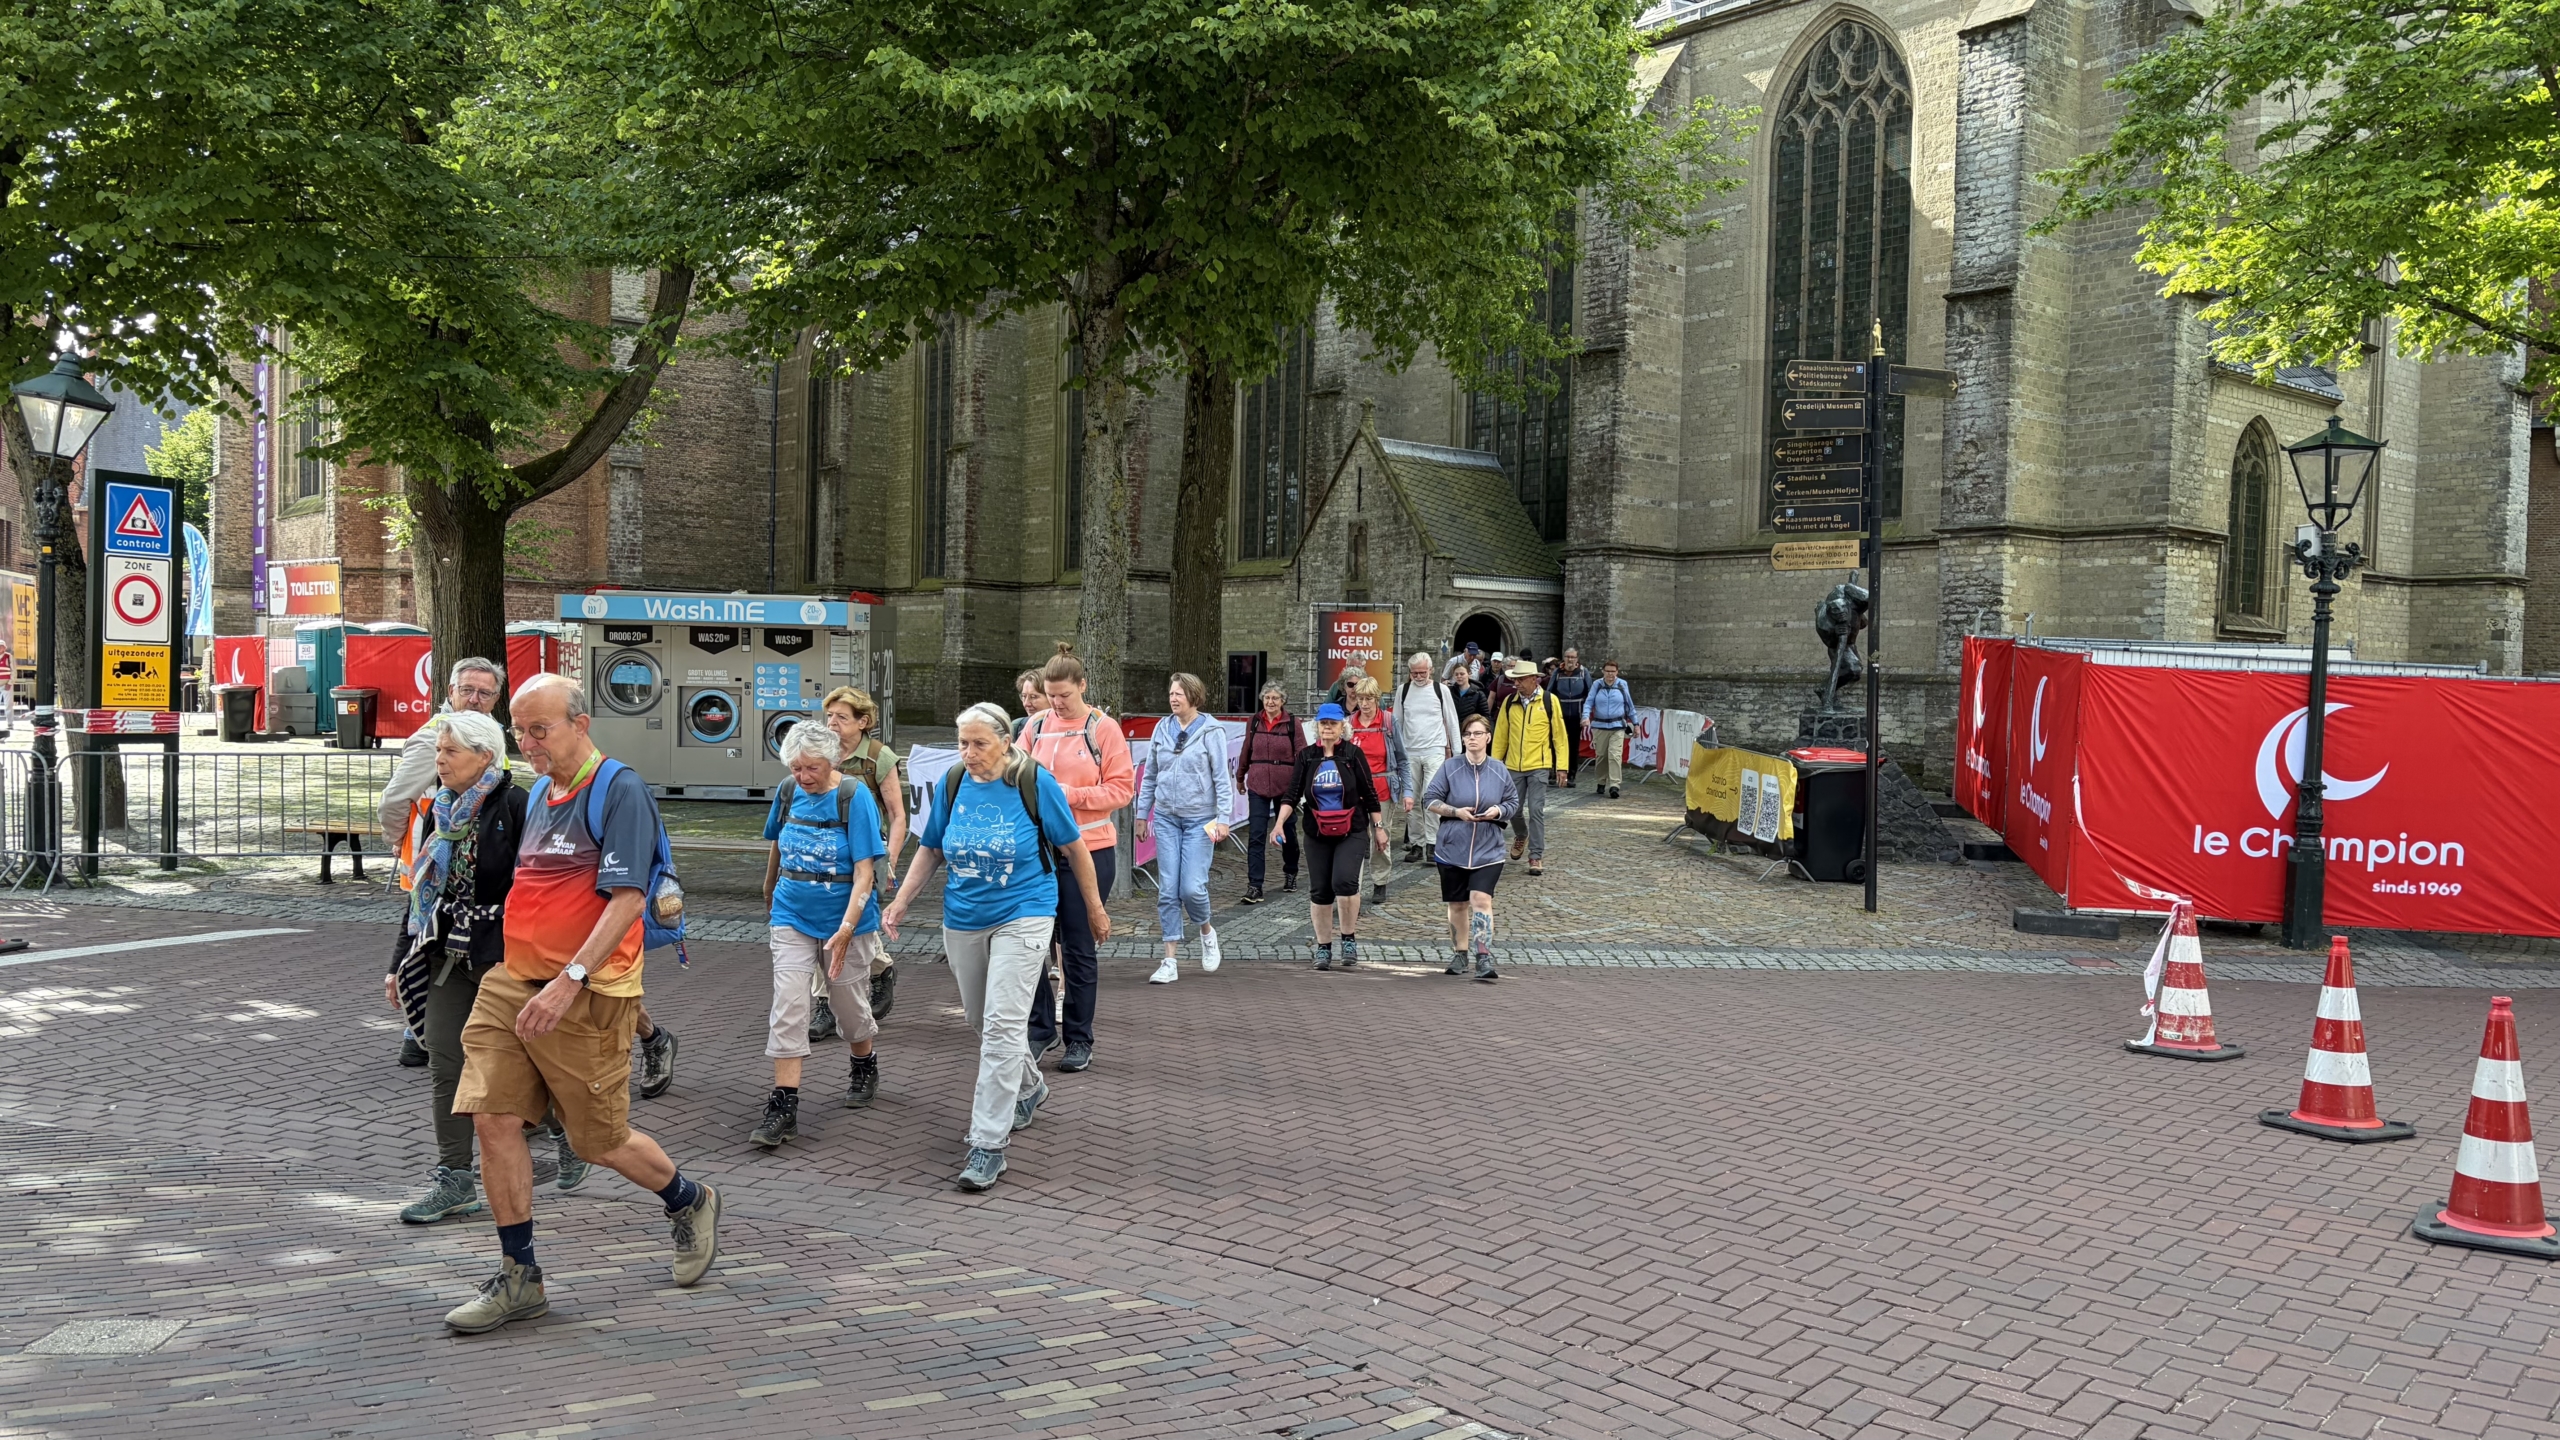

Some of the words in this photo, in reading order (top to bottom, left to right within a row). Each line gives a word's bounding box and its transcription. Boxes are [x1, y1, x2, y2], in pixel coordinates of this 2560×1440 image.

[1795, 403, 1826, 411] Stedelijk
[1787, 440, 1834, 448] Singelgarage
[1786, 448, 1823, 456] Karperton
[1787, 474, 1818, 482] Stadhuis
[1786, 487, 1859, 496] Kerken/Musea/Hofjes
[116, 539, 161, 550] controle
[124, 561, 153, 571] ZONE
[290, 580, 336, 596] TOILETTEN
[1333, 622, 1357, 633] LET
[1359, 622, 1378, 633] OP
[609, 632, 632, 640] DROOG
[698, 633, 714, 642] WAS
[775, 635, 791, 644] WAS
[1338, 635, 1373, 646] GEEN
[108, 649, 164, 658] uitgezonderd
[1328, 648, 1383, 660] INGNG!
[394, 699, 409, 713] le
[2193, 824, 2230, 856] le
[2240, 826, 2465, 872] Chmpion
[2372, 879, 2417, 895] sinds
[2418, 881, 2462, 896] 1969
